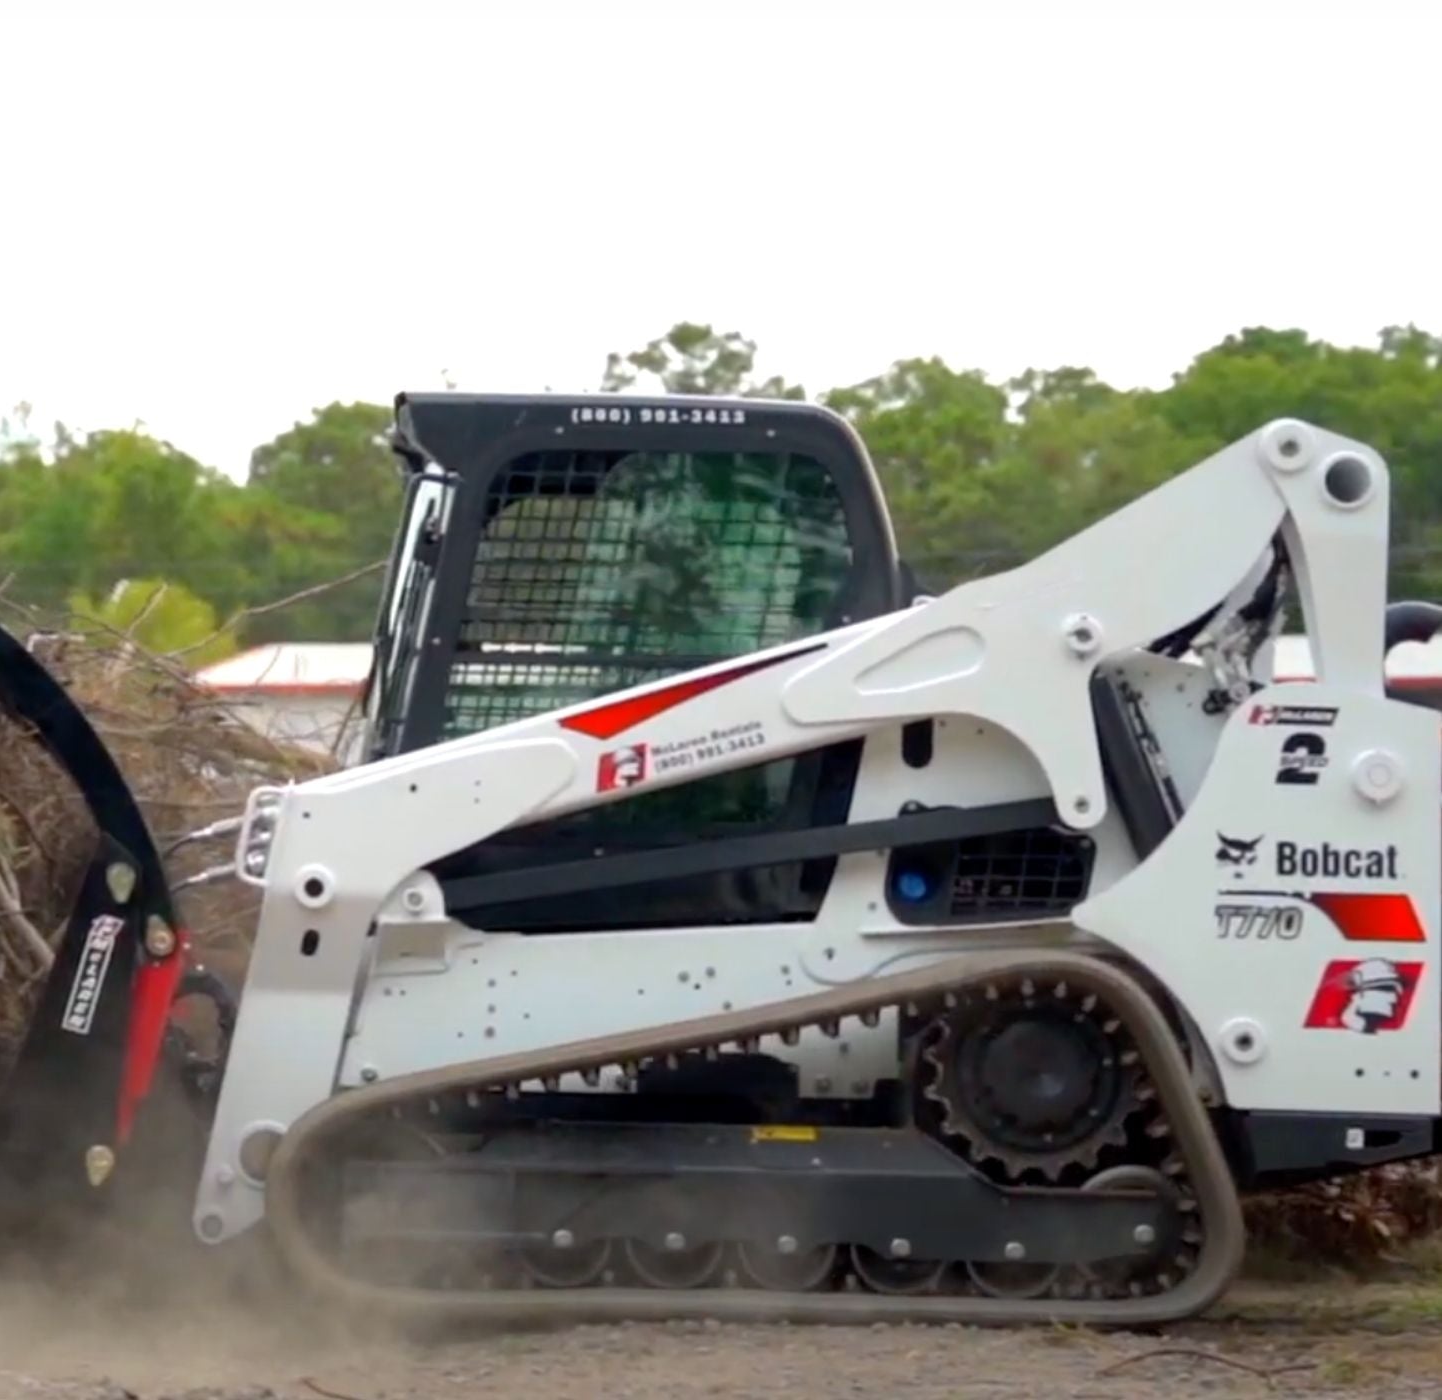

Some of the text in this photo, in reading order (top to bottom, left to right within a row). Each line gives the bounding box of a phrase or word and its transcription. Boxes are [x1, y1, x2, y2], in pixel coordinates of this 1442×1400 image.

[570, 406, 632, 425] (800)
[655, 754, 694, 772] (800)
[1275, 732, 1326, 785] 2
[1276, 841, 1398, 879] Bobcat
[1214, 904, 1304, 941] T770
